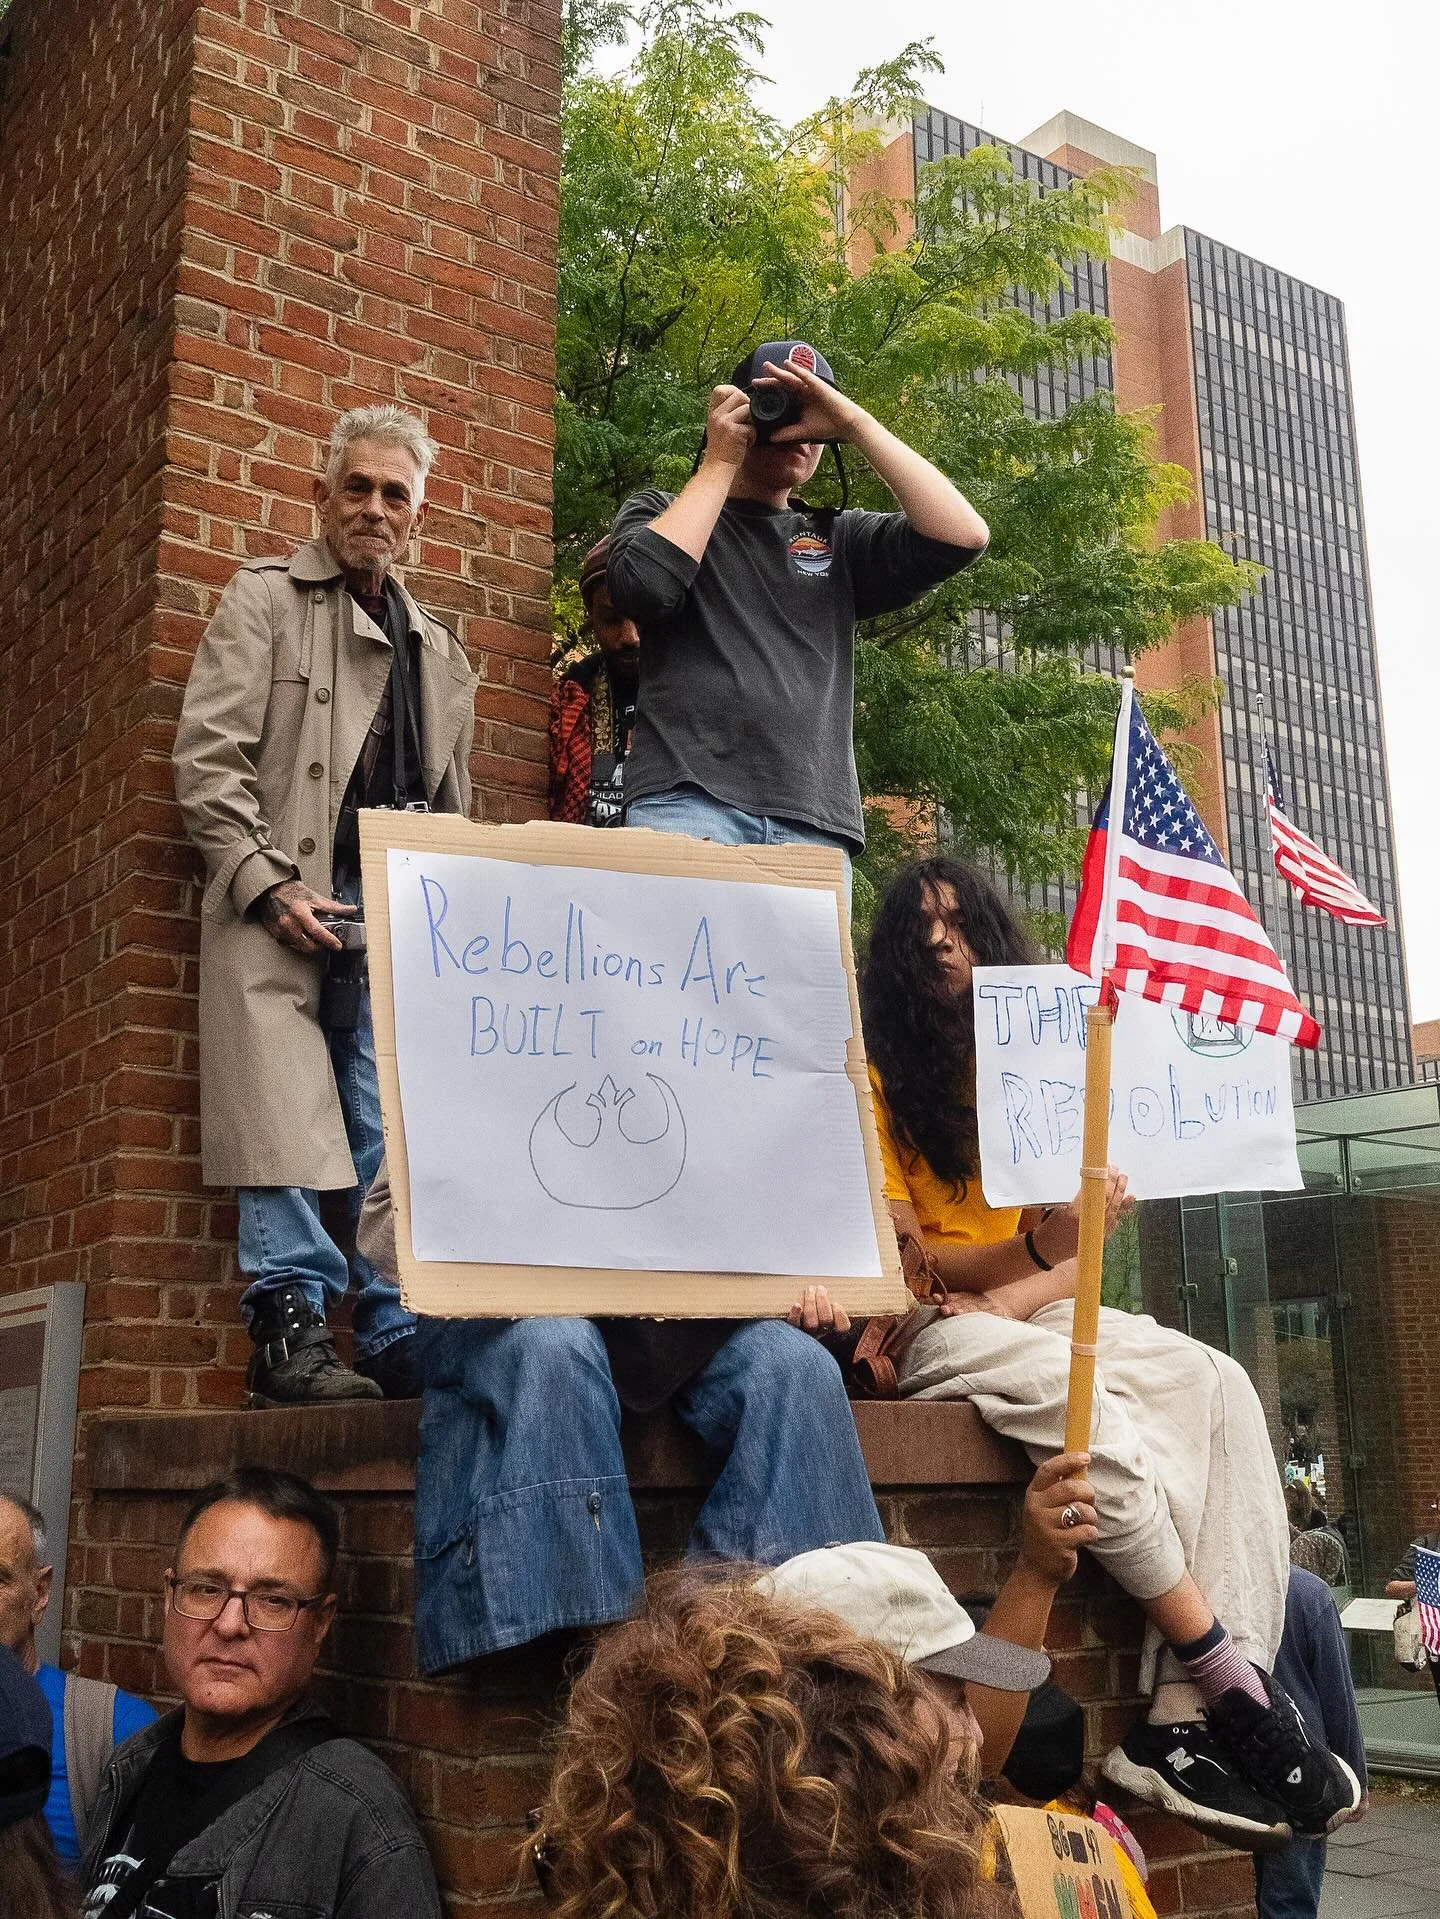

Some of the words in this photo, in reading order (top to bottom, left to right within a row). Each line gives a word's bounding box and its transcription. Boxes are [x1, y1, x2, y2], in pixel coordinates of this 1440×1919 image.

[419, 874, 665, 987] Rebellions
[680, 915, 769, 1005] Are
[470, 995, 605, 1059] BUILT
[630, 1035, 664, 1057] on
[680, 1016, 777, 1080] HOPE
[1001, 1063, 1279, 1166] REOLUTION
